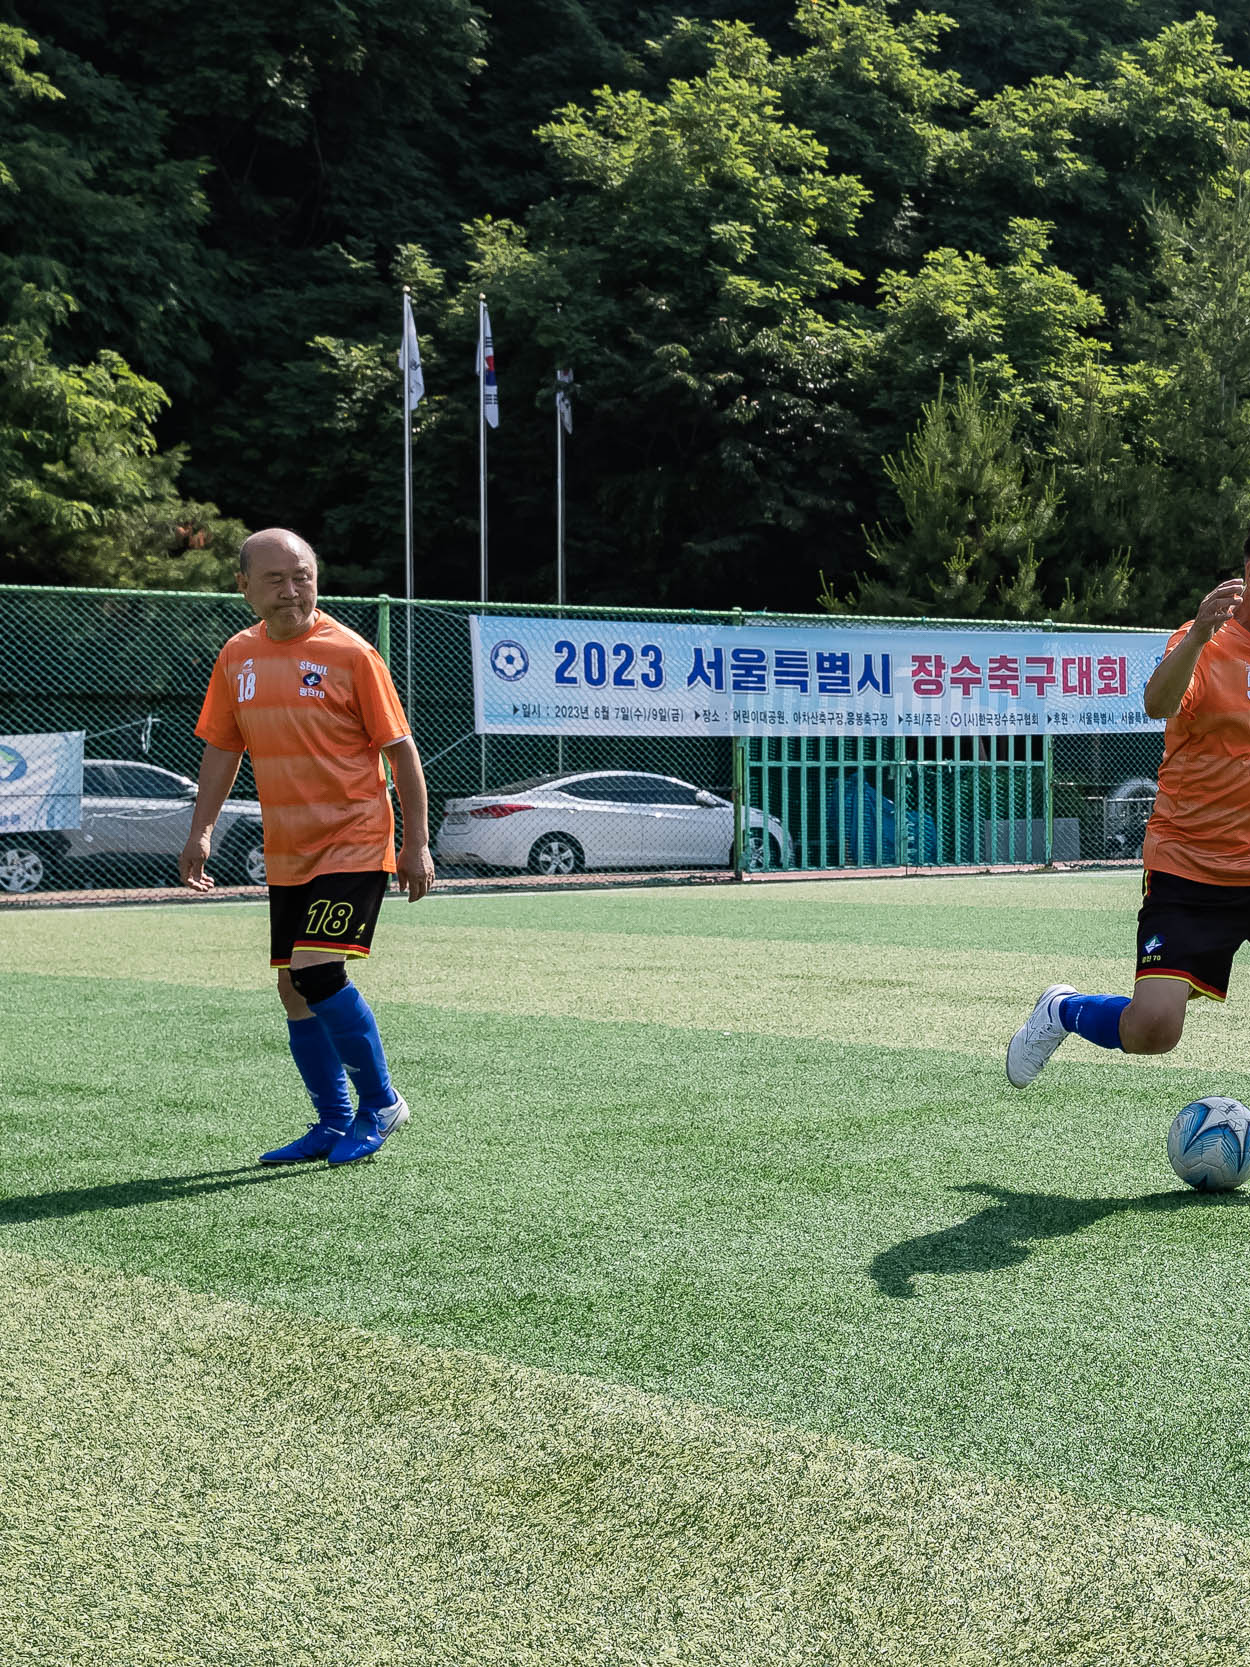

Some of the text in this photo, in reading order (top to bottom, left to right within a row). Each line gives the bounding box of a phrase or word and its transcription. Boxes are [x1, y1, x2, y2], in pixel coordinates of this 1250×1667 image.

[299, 660, 329, 676] SEOUL
[554, 639, 1127, 697] 2023 서울특별시 장수축구대회
[237, 672, 256, 703] 18
[555, 703, 590, 718] 2023년
[594, 704, 610, 721] 6월
[614, 706, 684, 722] 7일(수)/9일(금)
[305, 898, 354, 936] 18
